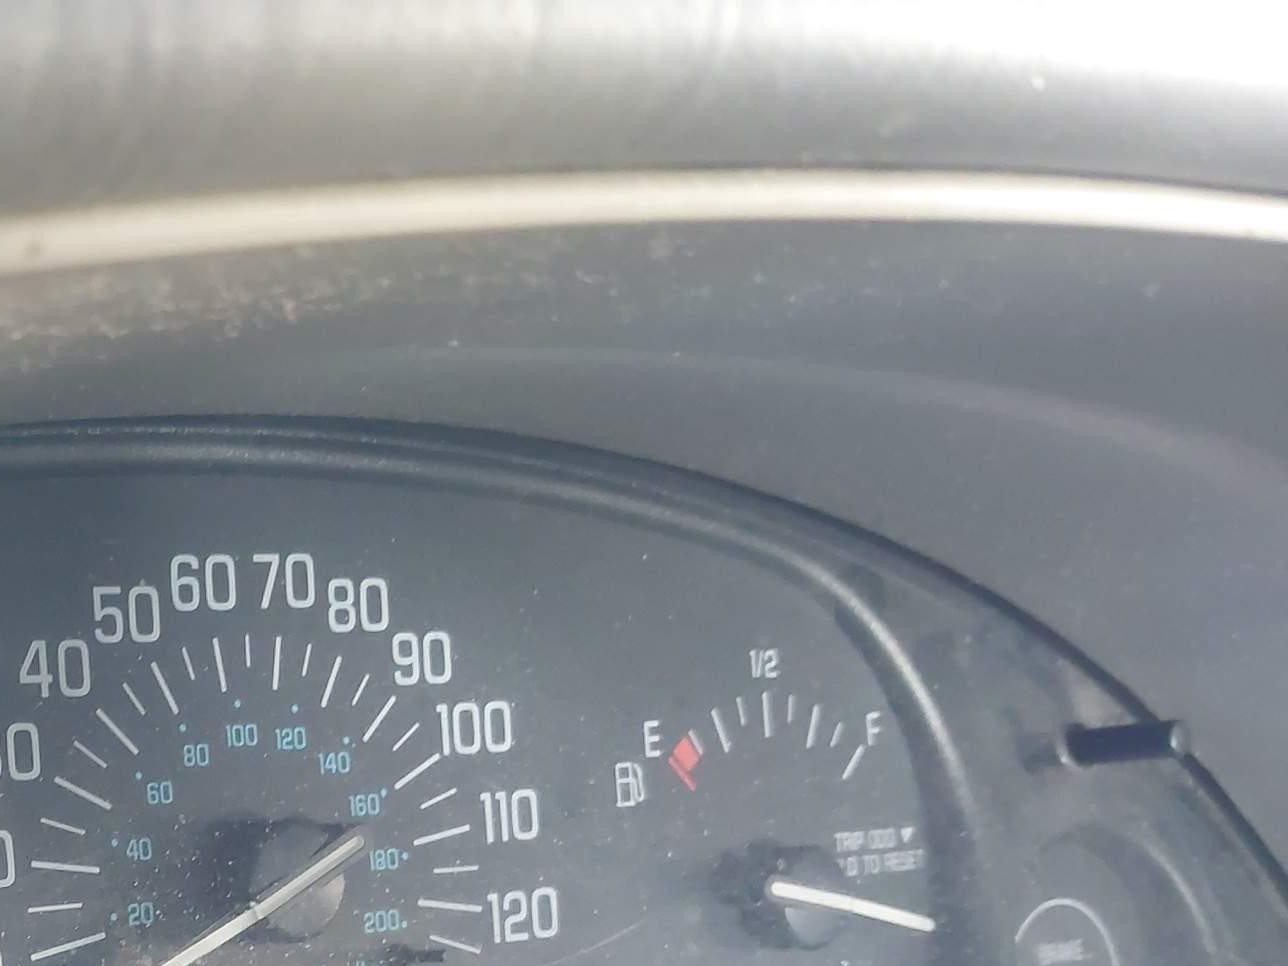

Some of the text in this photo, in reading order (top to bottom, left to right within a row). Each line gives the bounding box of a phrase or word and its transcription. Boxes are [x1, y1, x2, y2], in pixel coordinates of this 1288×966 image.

[170, 554, 237, 612] 60
[252, 553, 316, 609] 70
[92, 584, 161, 643] 50
[327, 577, 390, 633] 80
[18, 638, 92, 698] 40
[392, 631, 452, 686] 90
[749, 648, 780, 678] 1/2
[225, 723, 258, 748] 100
[275, 727, 306, 750] 120
[436, 700, 513, 755] 100
[643, 720, 662, 758] E
[866, 711, 881, 745] F
[183, 743, 209, 767] 80
[317, 751, 351, 775] 140
[146, 781, 173, 804] 60
[348, 794, 380, 818] 160
[479, 788, 539, 843] 110
[125, 838, 153, 861] 40
[369, 848, 399, 871] 180
[127, 903, 154, 926] 20
[363, 910, 400, 933] 200
[487, 886, 559, 944] 120
